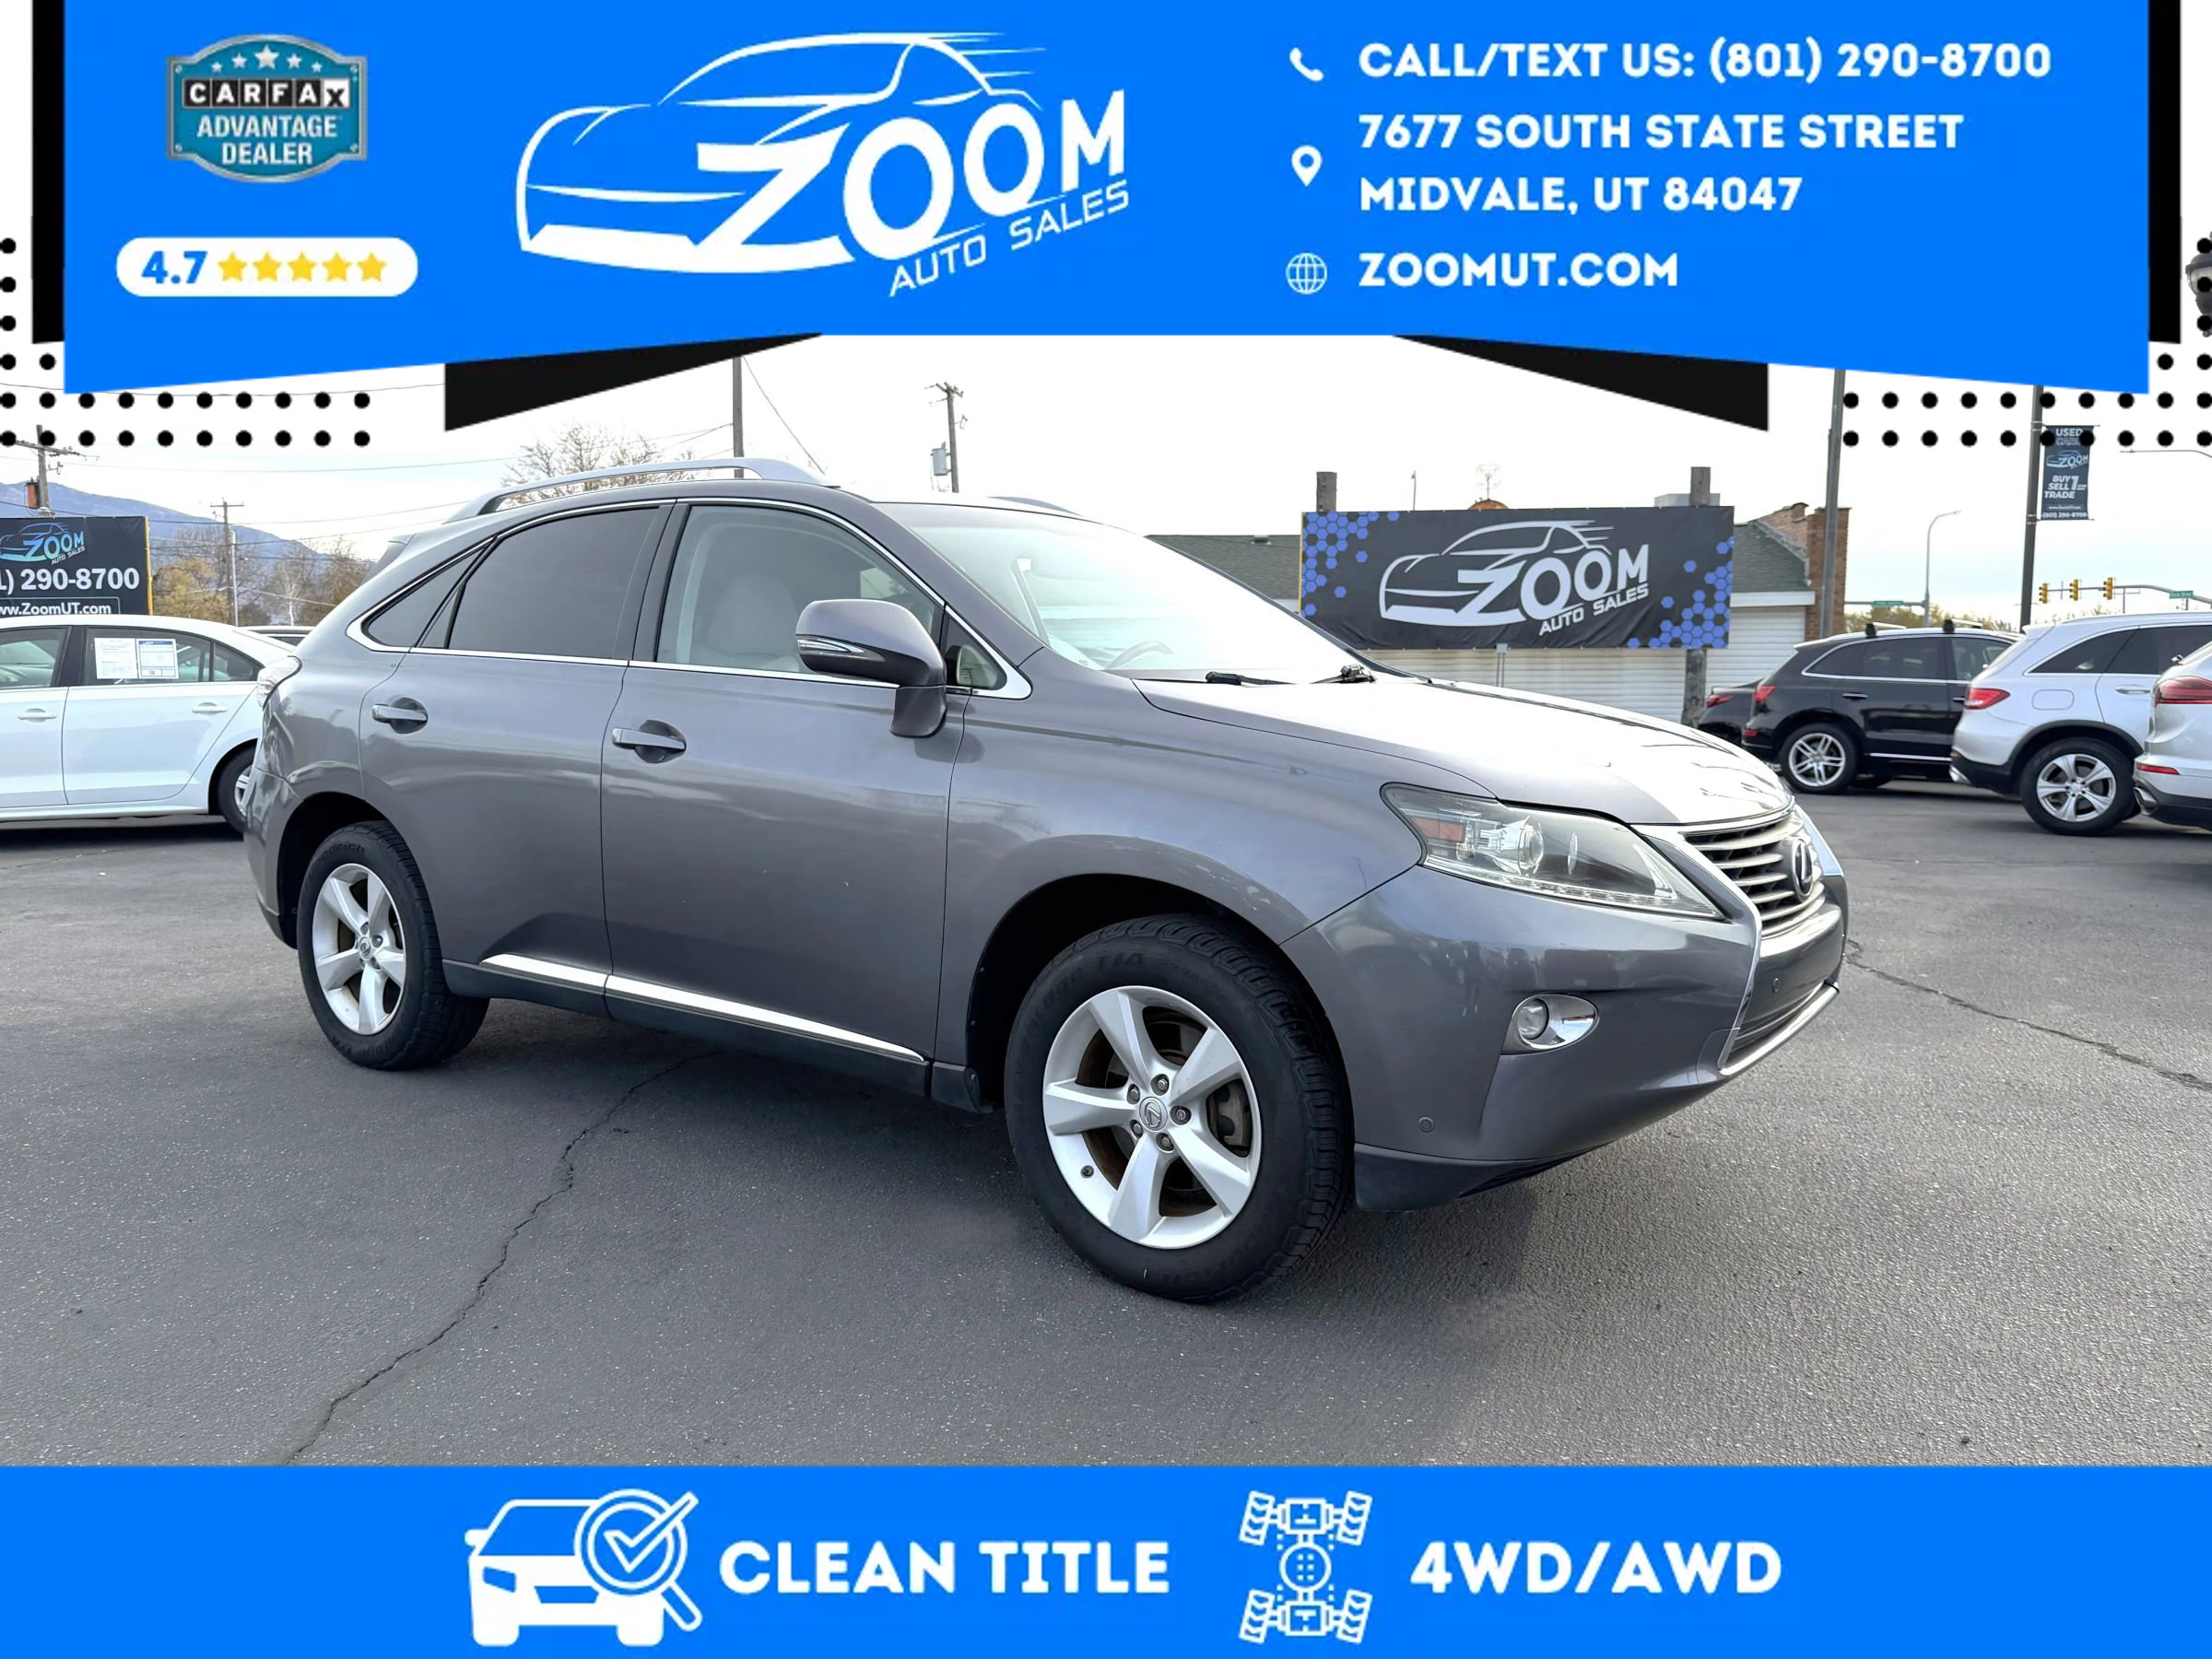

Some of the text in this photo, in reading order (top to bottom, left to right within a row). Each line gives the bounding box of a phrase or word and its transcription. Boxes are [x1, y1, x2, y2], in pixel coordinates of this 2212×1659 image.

[2055, 428, 2083, 437] USED
[23, 531, 85, 560] ZOOM
[20, 567, 140, 590] 290-8700
[1457, 544, 1650, 624] ZOOM
[1539, 582, 1650, 636] AUTO SALES
